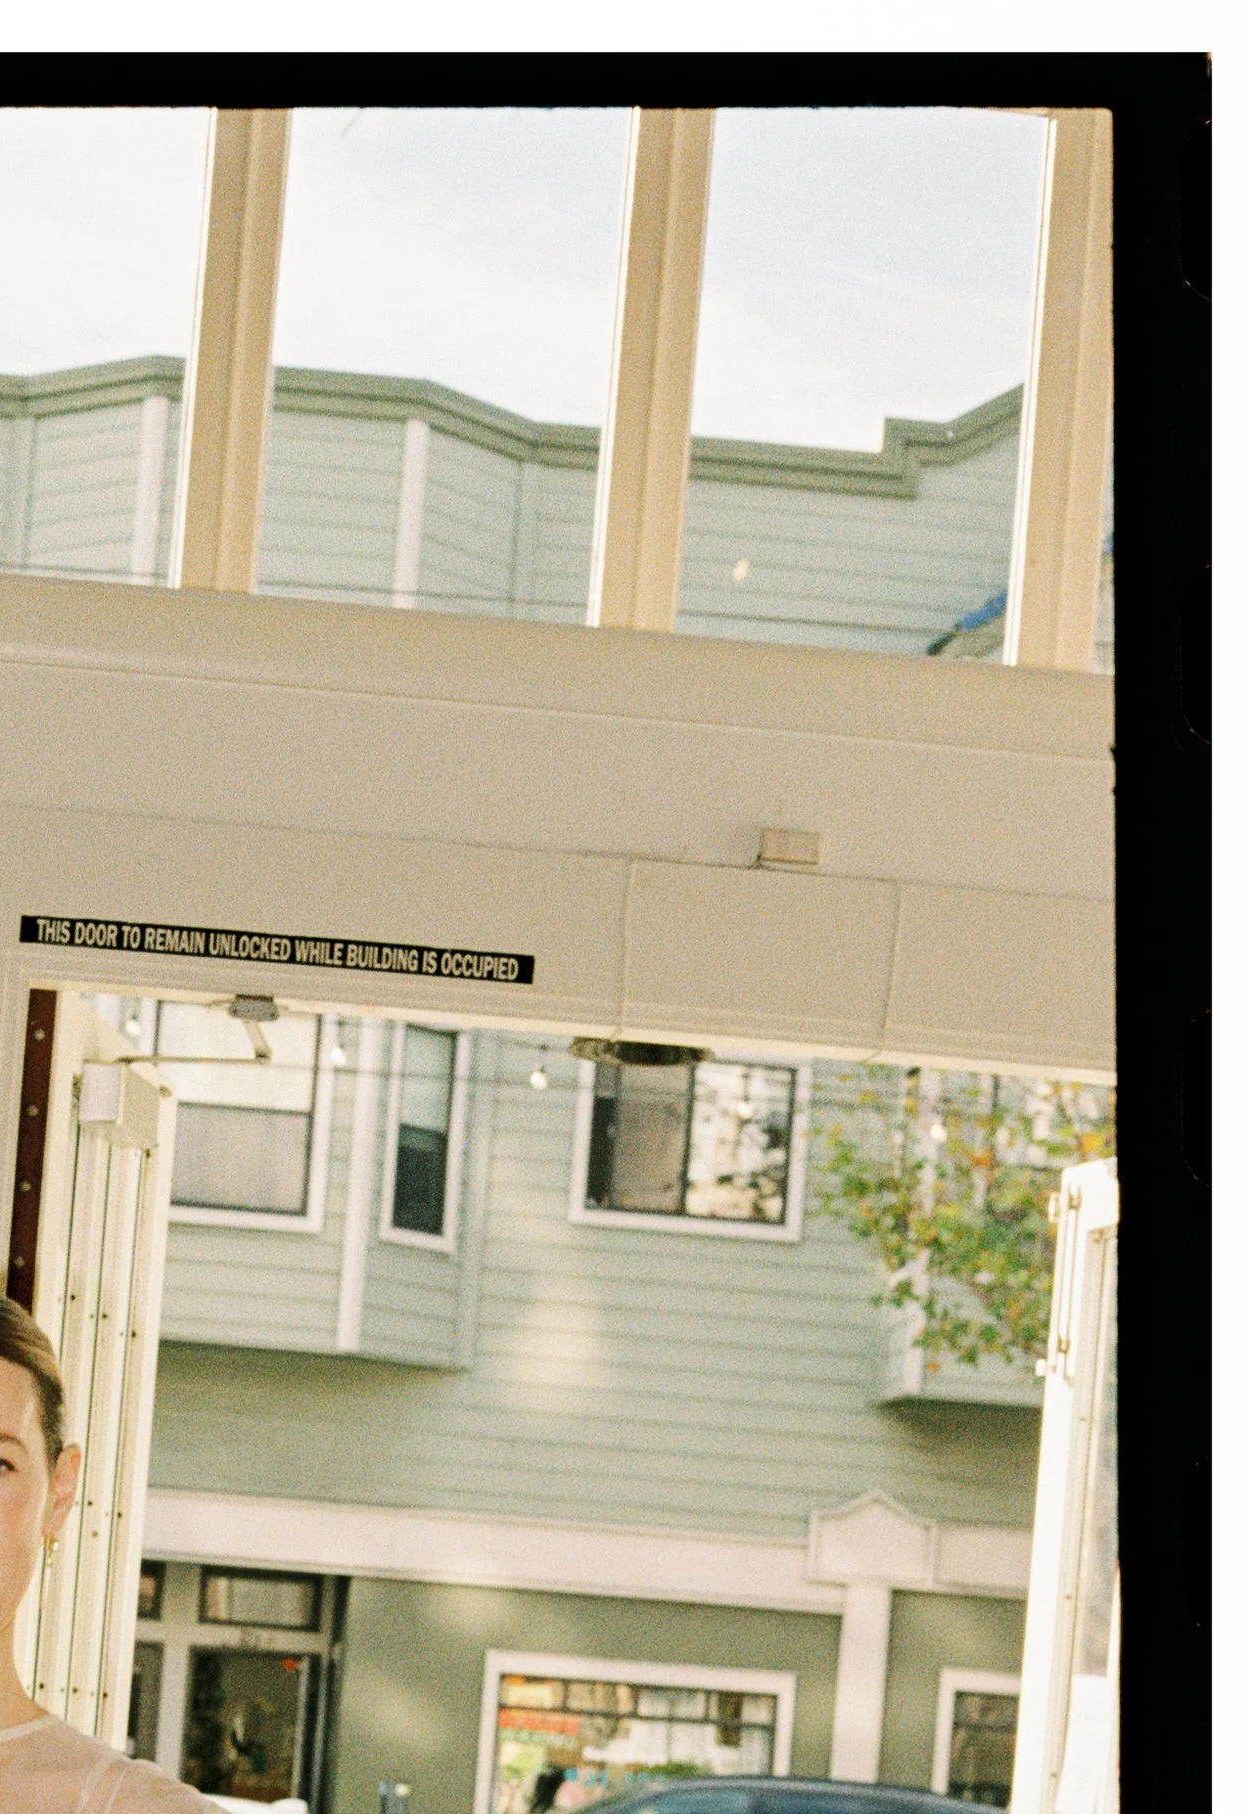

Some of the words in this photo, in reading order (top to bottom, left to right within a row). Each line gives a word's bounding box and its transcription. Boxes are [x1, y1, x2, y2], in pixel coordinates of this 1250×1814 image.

[36, 918, 71, 944] THIS
[73, 922, 117, 947] DOOR
[121, 925, 141, 949] TO
[144, 927, 205, 954] REMAIN
[209, 932, 291, 961] UNLOCKED
[295, 940, 344, 966] WHILE
[346, 944, 418, 972] BUILDING
[422, 950, 438, 974] IS
[441, 952, 519, 981] OCCUPIED
